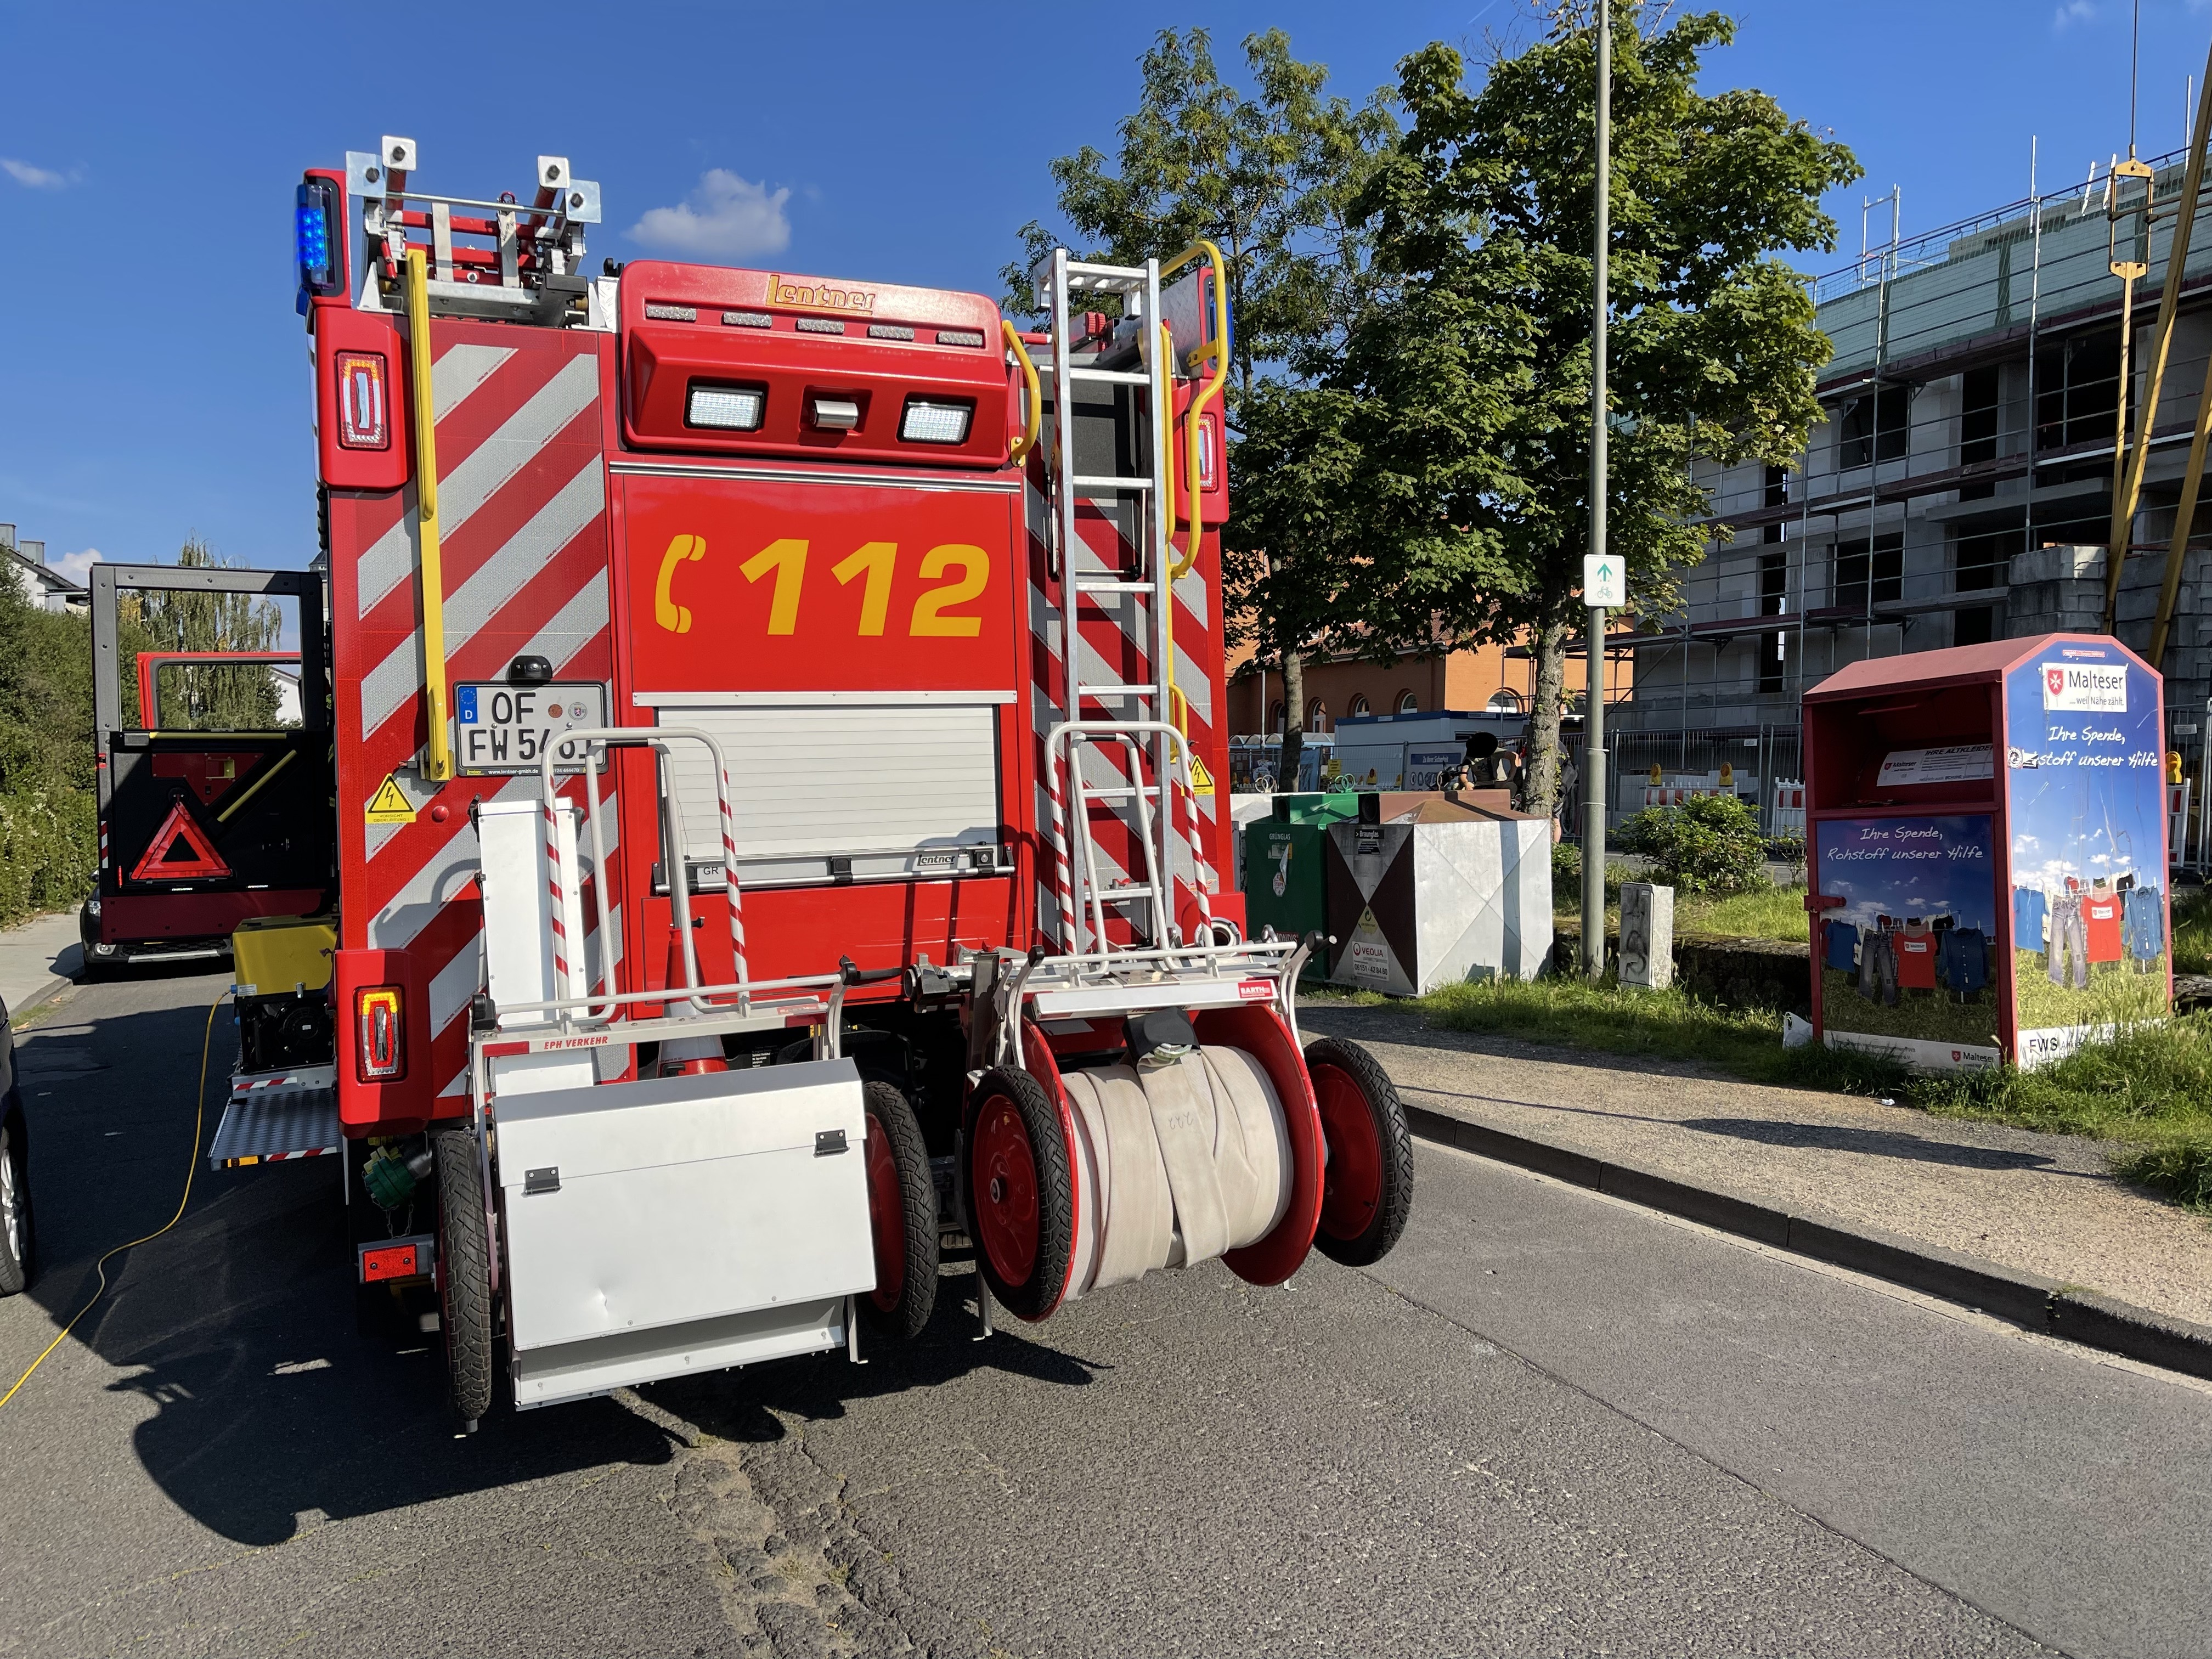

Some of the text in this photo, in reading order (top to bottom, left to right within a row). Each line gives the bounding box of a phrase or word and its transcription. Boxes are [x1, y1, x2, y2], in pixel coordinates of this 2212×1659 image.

[766, 274, 876, 316] Lentner
[739, 539, 990, 637] 112
[2069, 670, 2123, 689] Malteser
[492, 692, 536, 724] OF
[2091, 696, 2107, 705] Nähe
[465, 710, 473, 719] D
[2048, 726, 2125, 746] Ihre Spende,
[469, 729, 508, 761] FW
[2035, 751, 2077, 766] stoff
[2078, 754, 2124, 766] unserer
[2129, 751, 2158, 768] Hilfe
[1359, 830, 1379, 839] Braunglas
[1860, 826, 1943, 842] Ihre Spende,
[1827, 845, 1983, 861] Rohstoff unserer Hilfe
[703, 866, 719, 874] GR
[1362, 947, 1384, 957] VEOLIA
[544, 1036, 608, 1049] EPH VERKEHR
